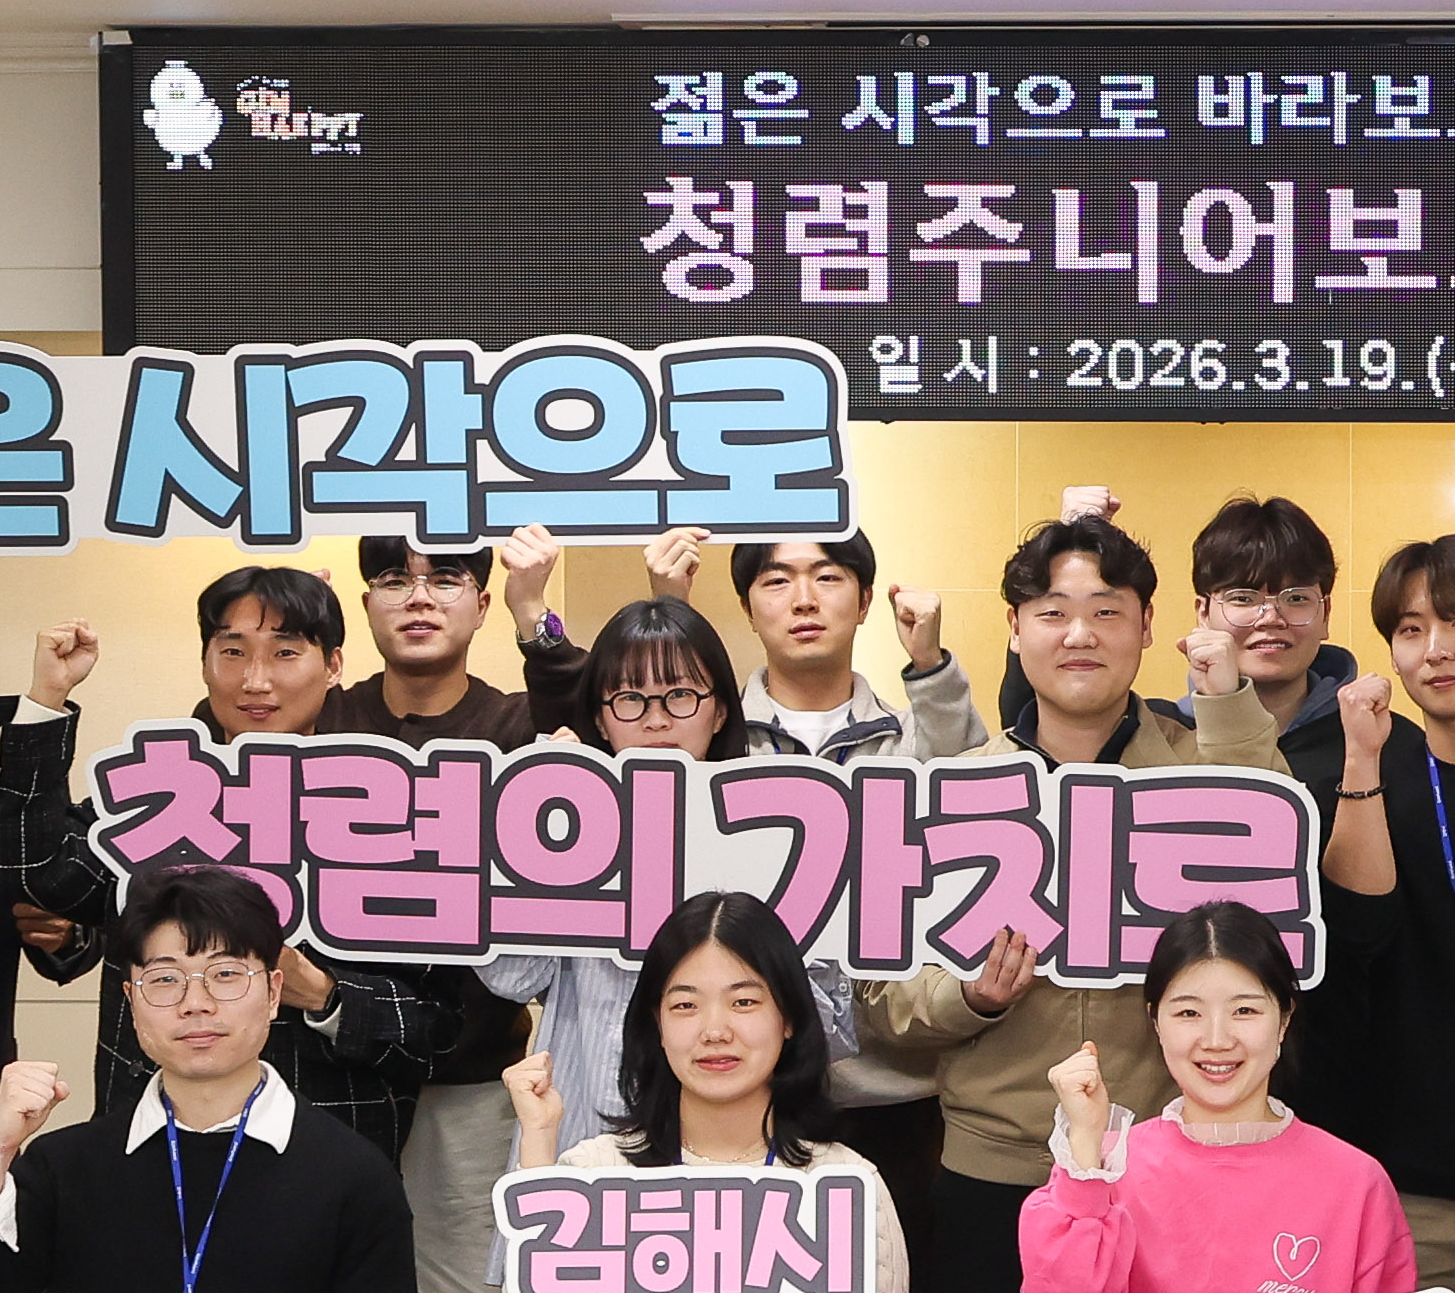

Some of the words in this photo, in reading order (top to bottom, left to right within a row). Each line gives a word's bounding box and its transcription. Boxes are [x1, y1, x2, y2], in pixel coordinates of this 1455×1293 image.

[651, 72, 808, 145] 젊은
[842, 72, 1165, 146] 시각으로
[868, 335, 924, 394] 일
[943, 335, 1000, 394] 시
[117, 356, 842, 536] 시각으로
[106, 739, 677, 949] 청렴의
[721, 772, 1305, 969] 가치로
